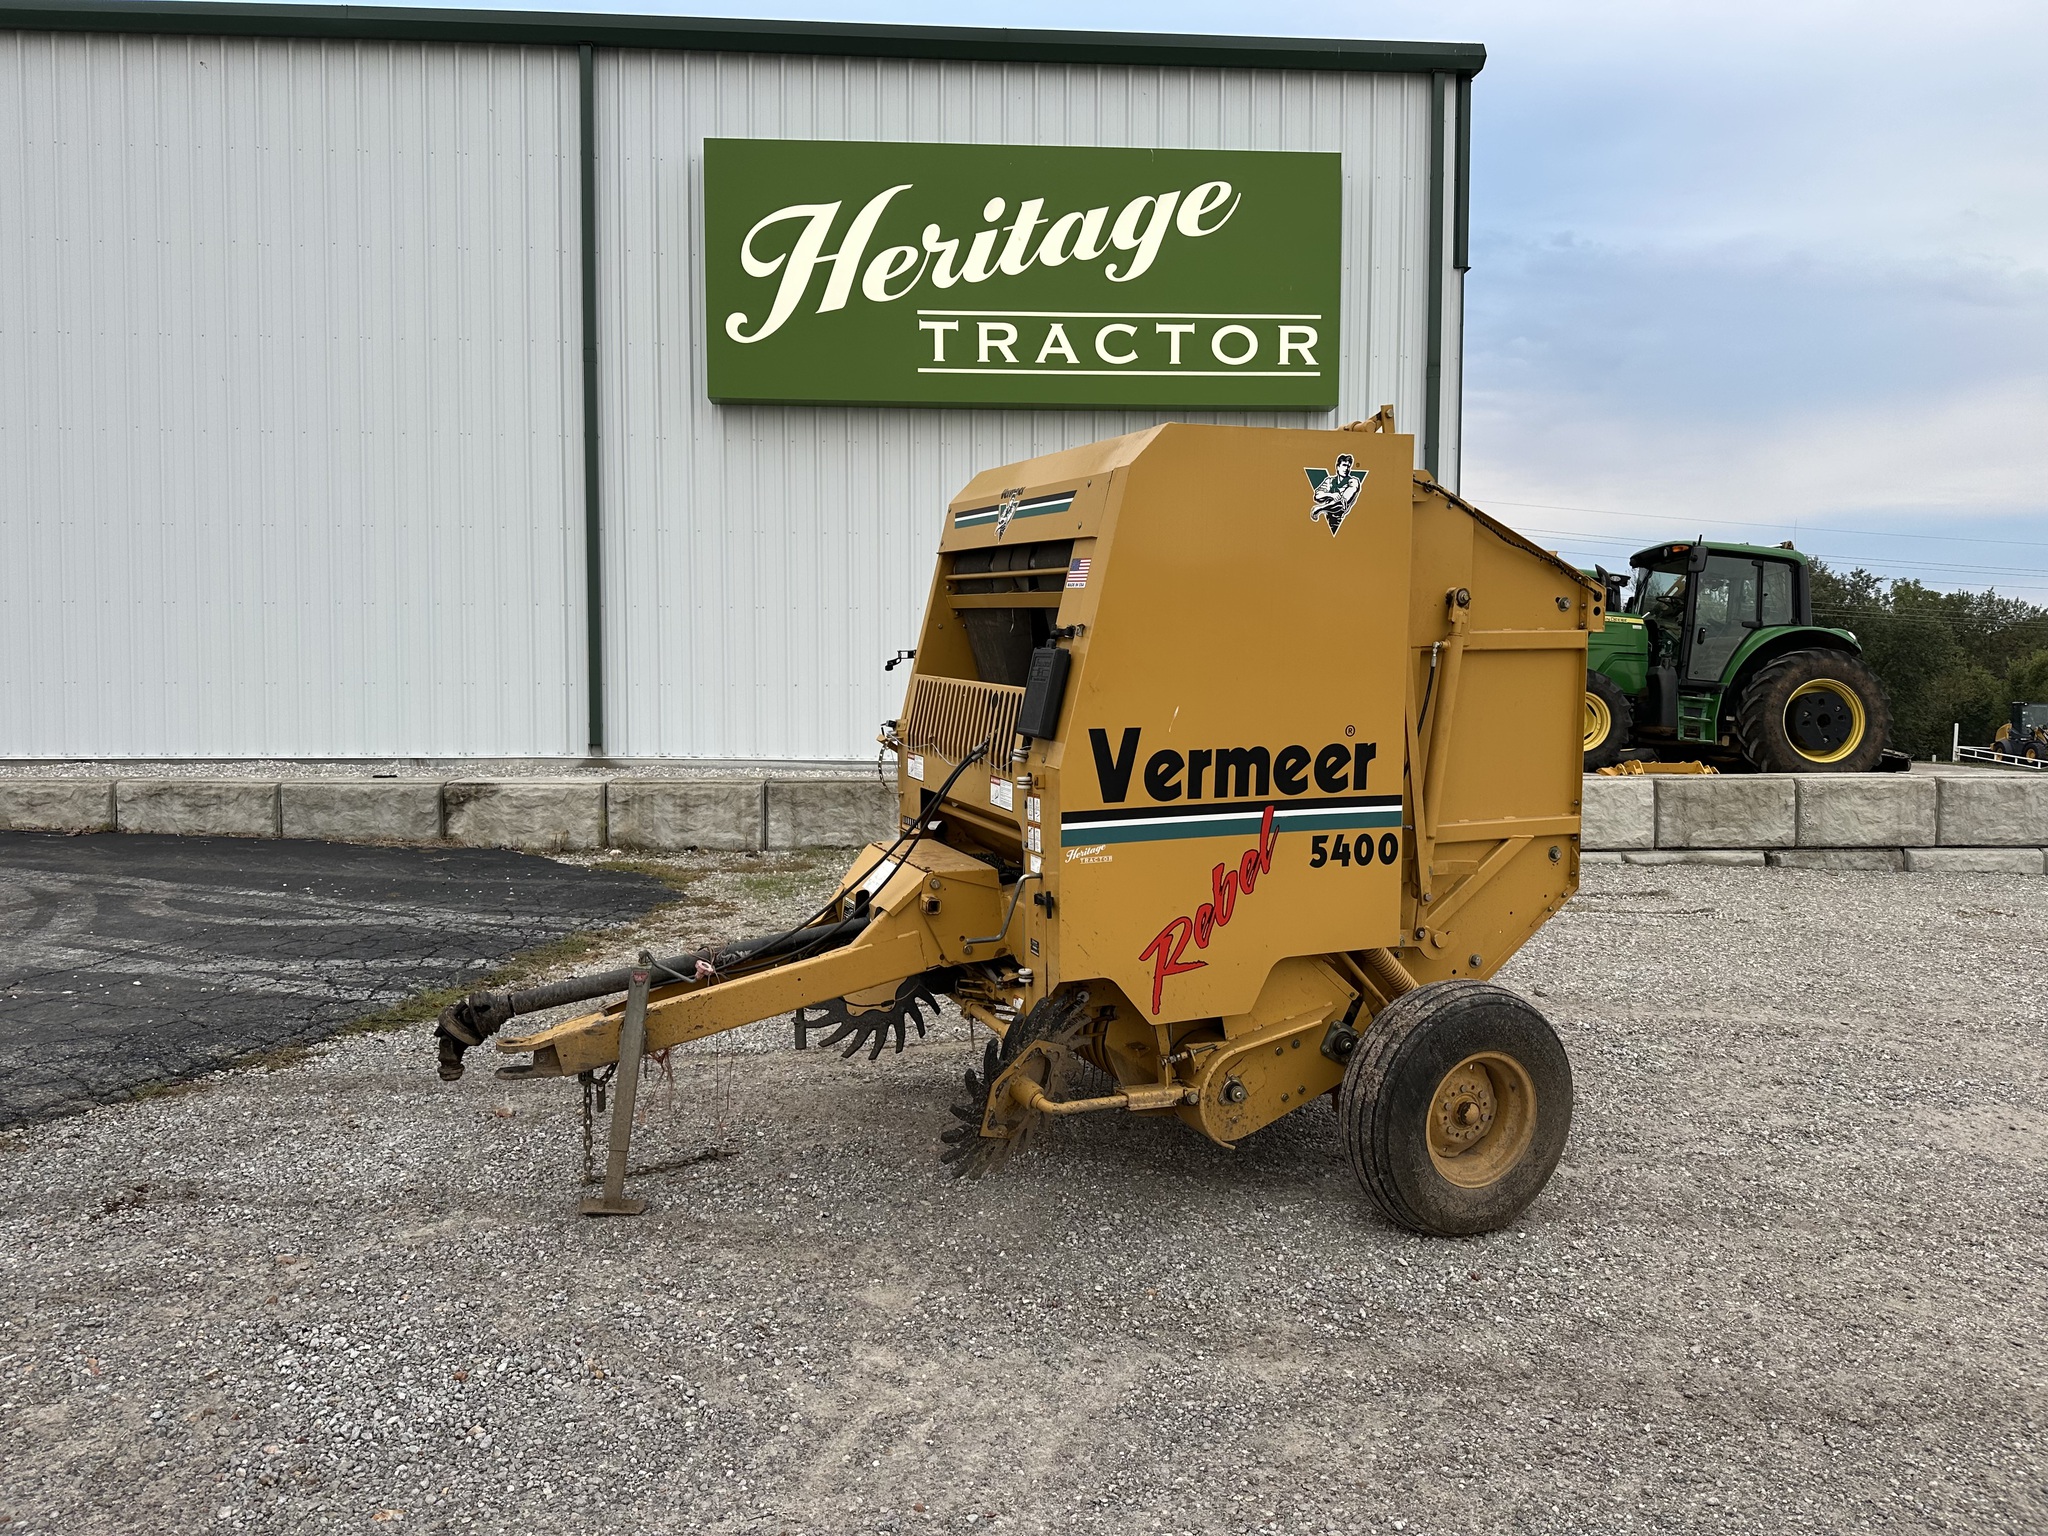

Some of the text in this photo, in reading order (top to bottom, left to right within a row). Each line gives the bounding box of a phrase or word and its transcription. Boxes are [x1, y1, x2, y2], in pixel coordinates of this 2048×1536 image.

[725, 180, 1241, 344] Heritage
[918, 320, 1320, 366] TRACTOR
[1088, 727, 1377, 804] Vermeer
[1065, 844, 1106, 863] Heritage
[1080, 855, 1113, 863] TRACTOR
[1309, 832, 1399, 869] 5400
[1138, 805, 1280, 1015] Rebel
